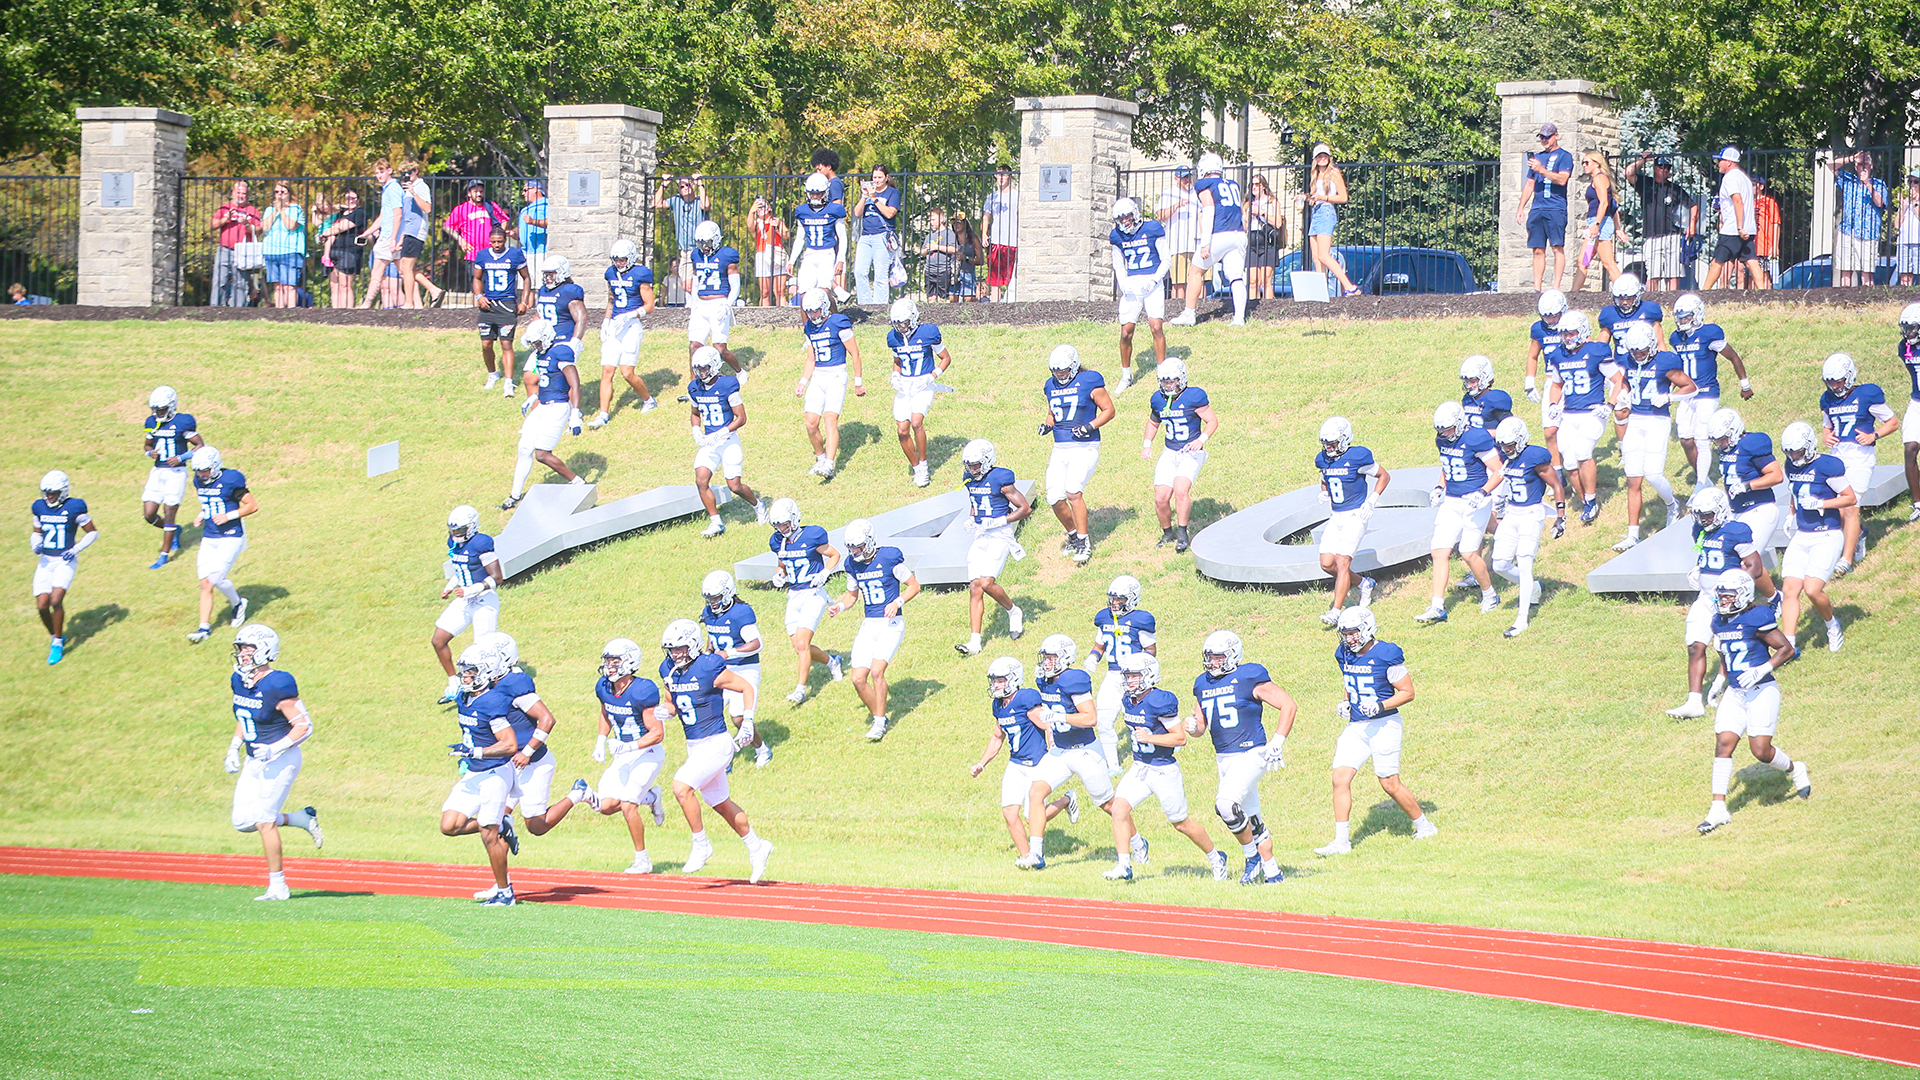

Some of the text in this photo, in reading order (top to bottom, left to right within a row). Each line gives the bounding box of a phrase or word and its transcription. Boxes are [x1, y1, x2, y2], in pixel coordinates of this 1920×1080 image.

[1217, 182, 1241, 207] 90
[809, 226, 824, 247] 11
[1124, 246, 1153, 270] 22
[487, 270, 509, 291] 13
[614, 288, 628, 308] 3
[813, 340, 832, 362] 15
[899, 352, 924, 376] 37
[1681, 353, 1697, 380] 11
[698, 403, 725, 427] 28
[1050, 395, 1079, 423] 67
[1831, 414, 1857, 437] 17
[1328, 477, 1345, 504] 8
[41, 524, 67, 549] 21
[858, 579, 887, 605] 16
[1102, 634, 1132, 662] 26
[676, 695, 697, 726] 9
[1201, 695, 1240, 730] 75
[236, 708, 258, 742] 0
[607, 713, 642, 742] 14
